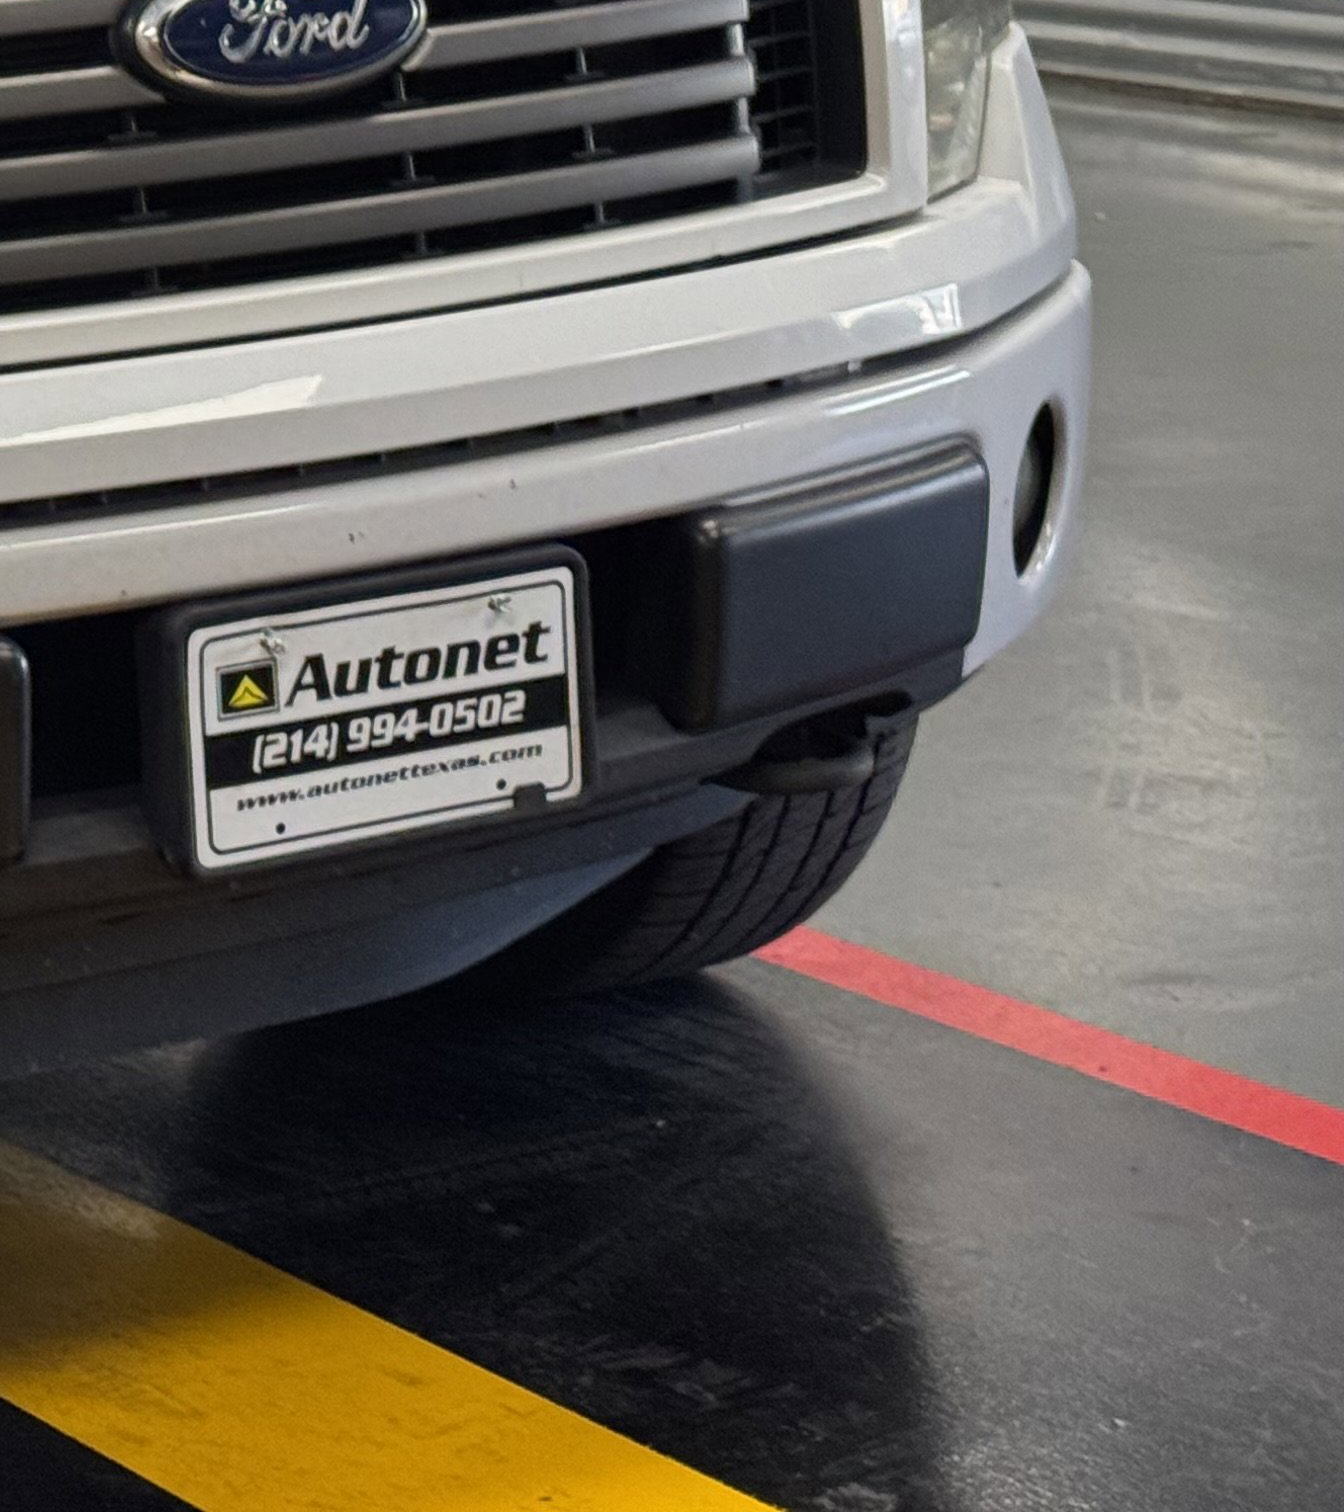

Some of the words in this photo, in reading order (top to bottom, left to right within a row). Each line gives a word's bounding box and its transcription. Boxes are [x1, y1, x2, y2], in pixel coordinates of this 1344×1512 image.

[285, 620, 550, 708] Autonet
[252, 722, 339, 775] (214)
[347, 689, 526, 753] 994-0502
[236, 743, 543, 812] www.autonettexas.com
